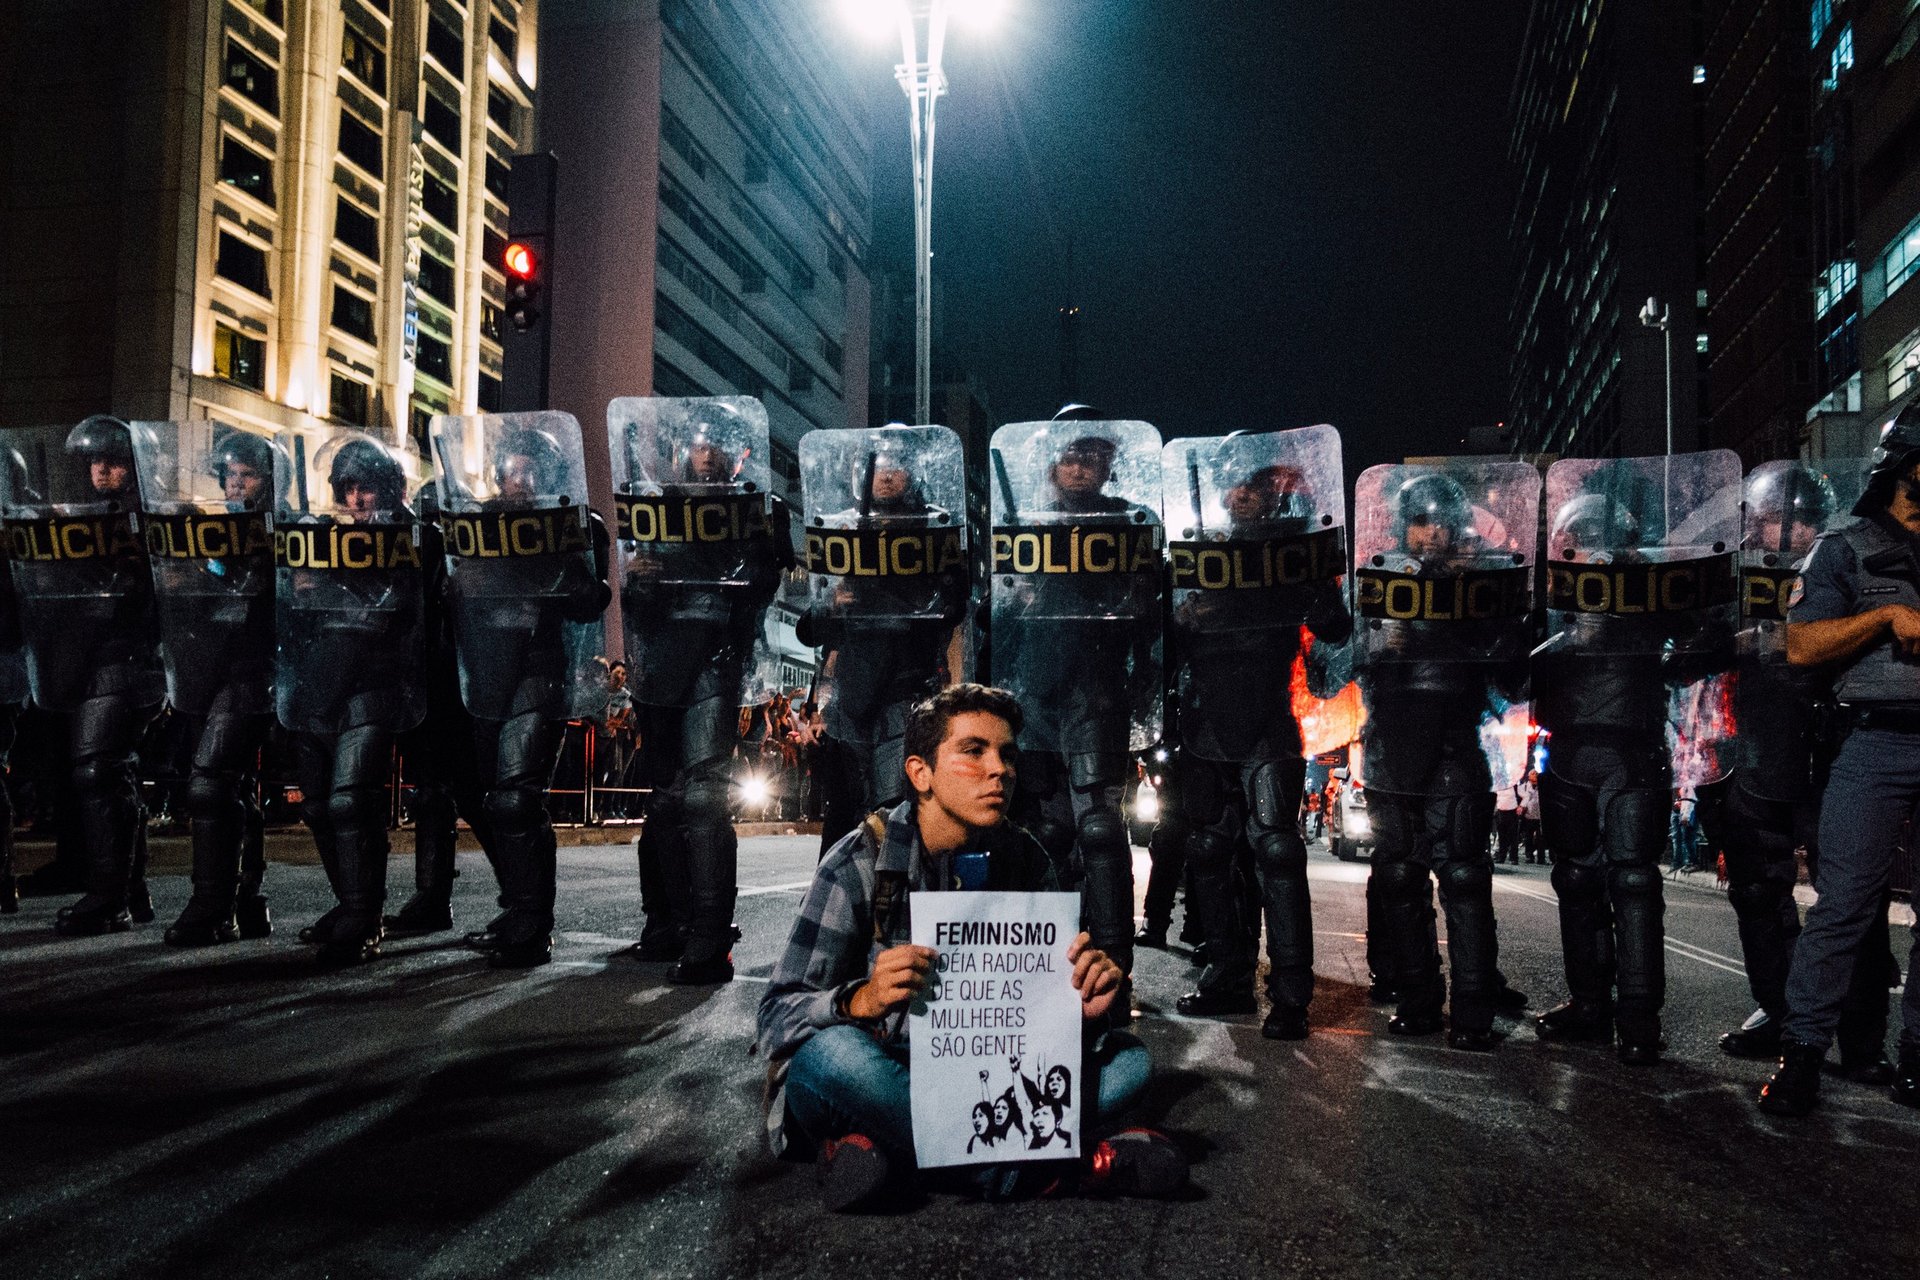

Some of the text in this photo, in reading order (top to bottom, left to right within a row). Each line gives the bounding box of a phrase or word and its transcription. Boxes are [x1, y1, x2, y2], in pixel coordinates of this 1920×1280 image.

[805, 528, 964, 577] POLÍCIA
[991, 524, 1158, 574] POLÍCIA
[935, 921, 1057, 946] FEMINISMO
[982, 952, 1056, 973] RADICAL
[959, 979, 995, 1001] QUE
[1000, 979, 1023, 1000] AS
[931, 1006, 1026, 1029] MULHERES
[931, 1032, 1027, 1058] SÃO GENTE
